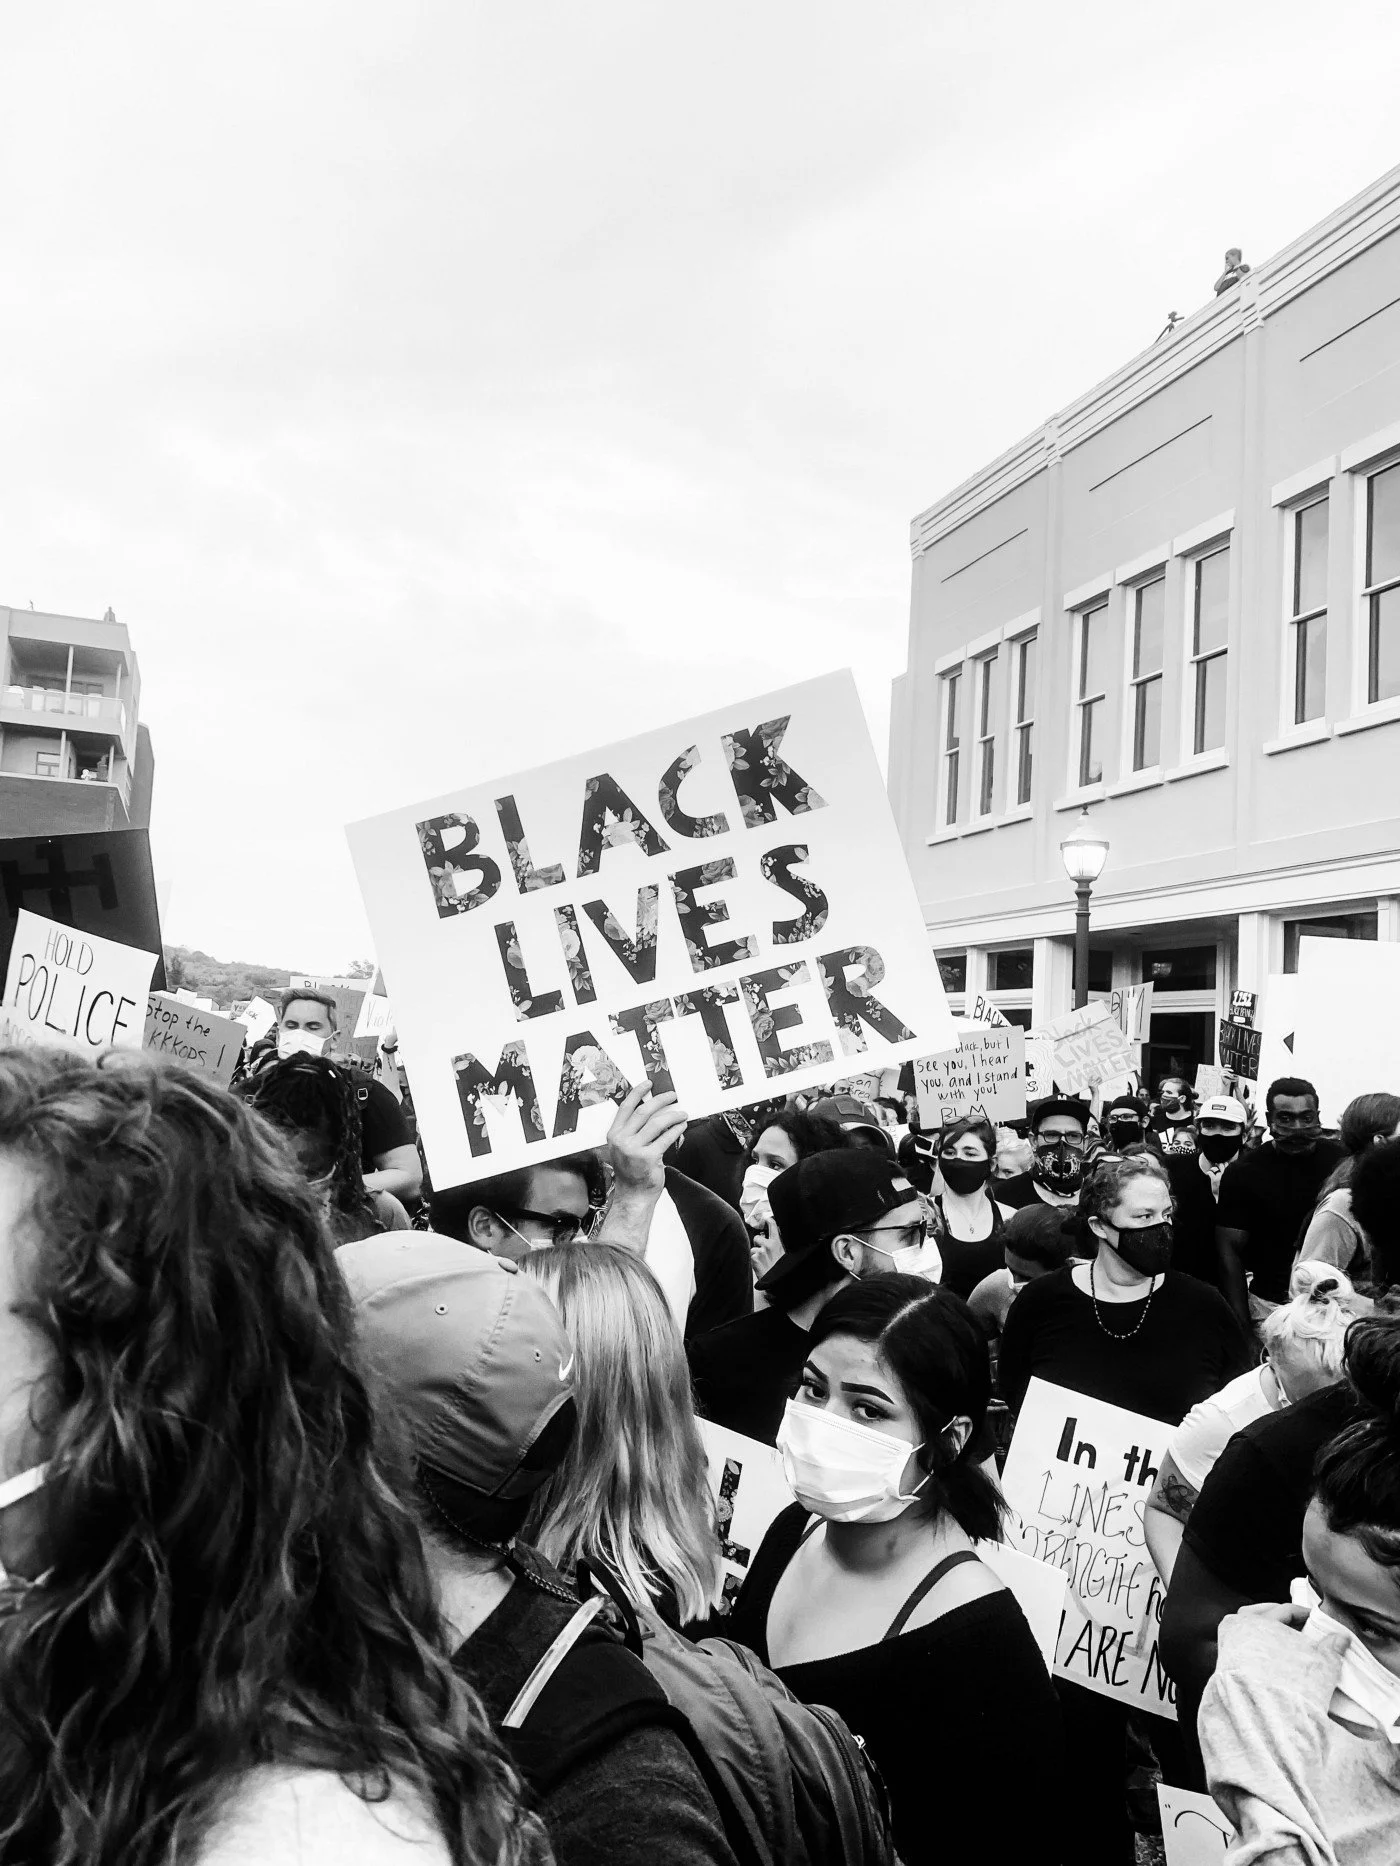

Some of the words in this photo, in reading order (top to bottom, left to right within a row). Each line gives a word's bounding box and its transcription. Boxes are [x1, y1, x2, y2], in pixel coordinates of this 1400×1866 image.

[415, 714, 829, 919] BLACK
[45, 928, 93, 975] HOLD
[493, 844, 829, 1022] LIVES
[146, 997, 179, 1030] Stop
[186, 1015, 211, 1037] the
[451, 945, 917, 1158] MATTER
[972, 1054, 976, 1067] I
[980, 1053, 1009, 1067] hear
[984, 1037, 1000, 1049] but
[1005, 1037, 1010, 1049] I
[1054, 1030, 1123, 1068] LIVES
[938, 1088, 966, 1101] with
[974, 1083, 997, 1101] you!
[949, 1073, 972, 1087] and
[977, 1072, 981, 1084] I
[941, 1104, 988, 1121] BLM
[1056, 1417, 1097, 1469] In
[1038, 1470, 1147, 1547] LINES
[1064, 1619, 1134, 1686] ARE
